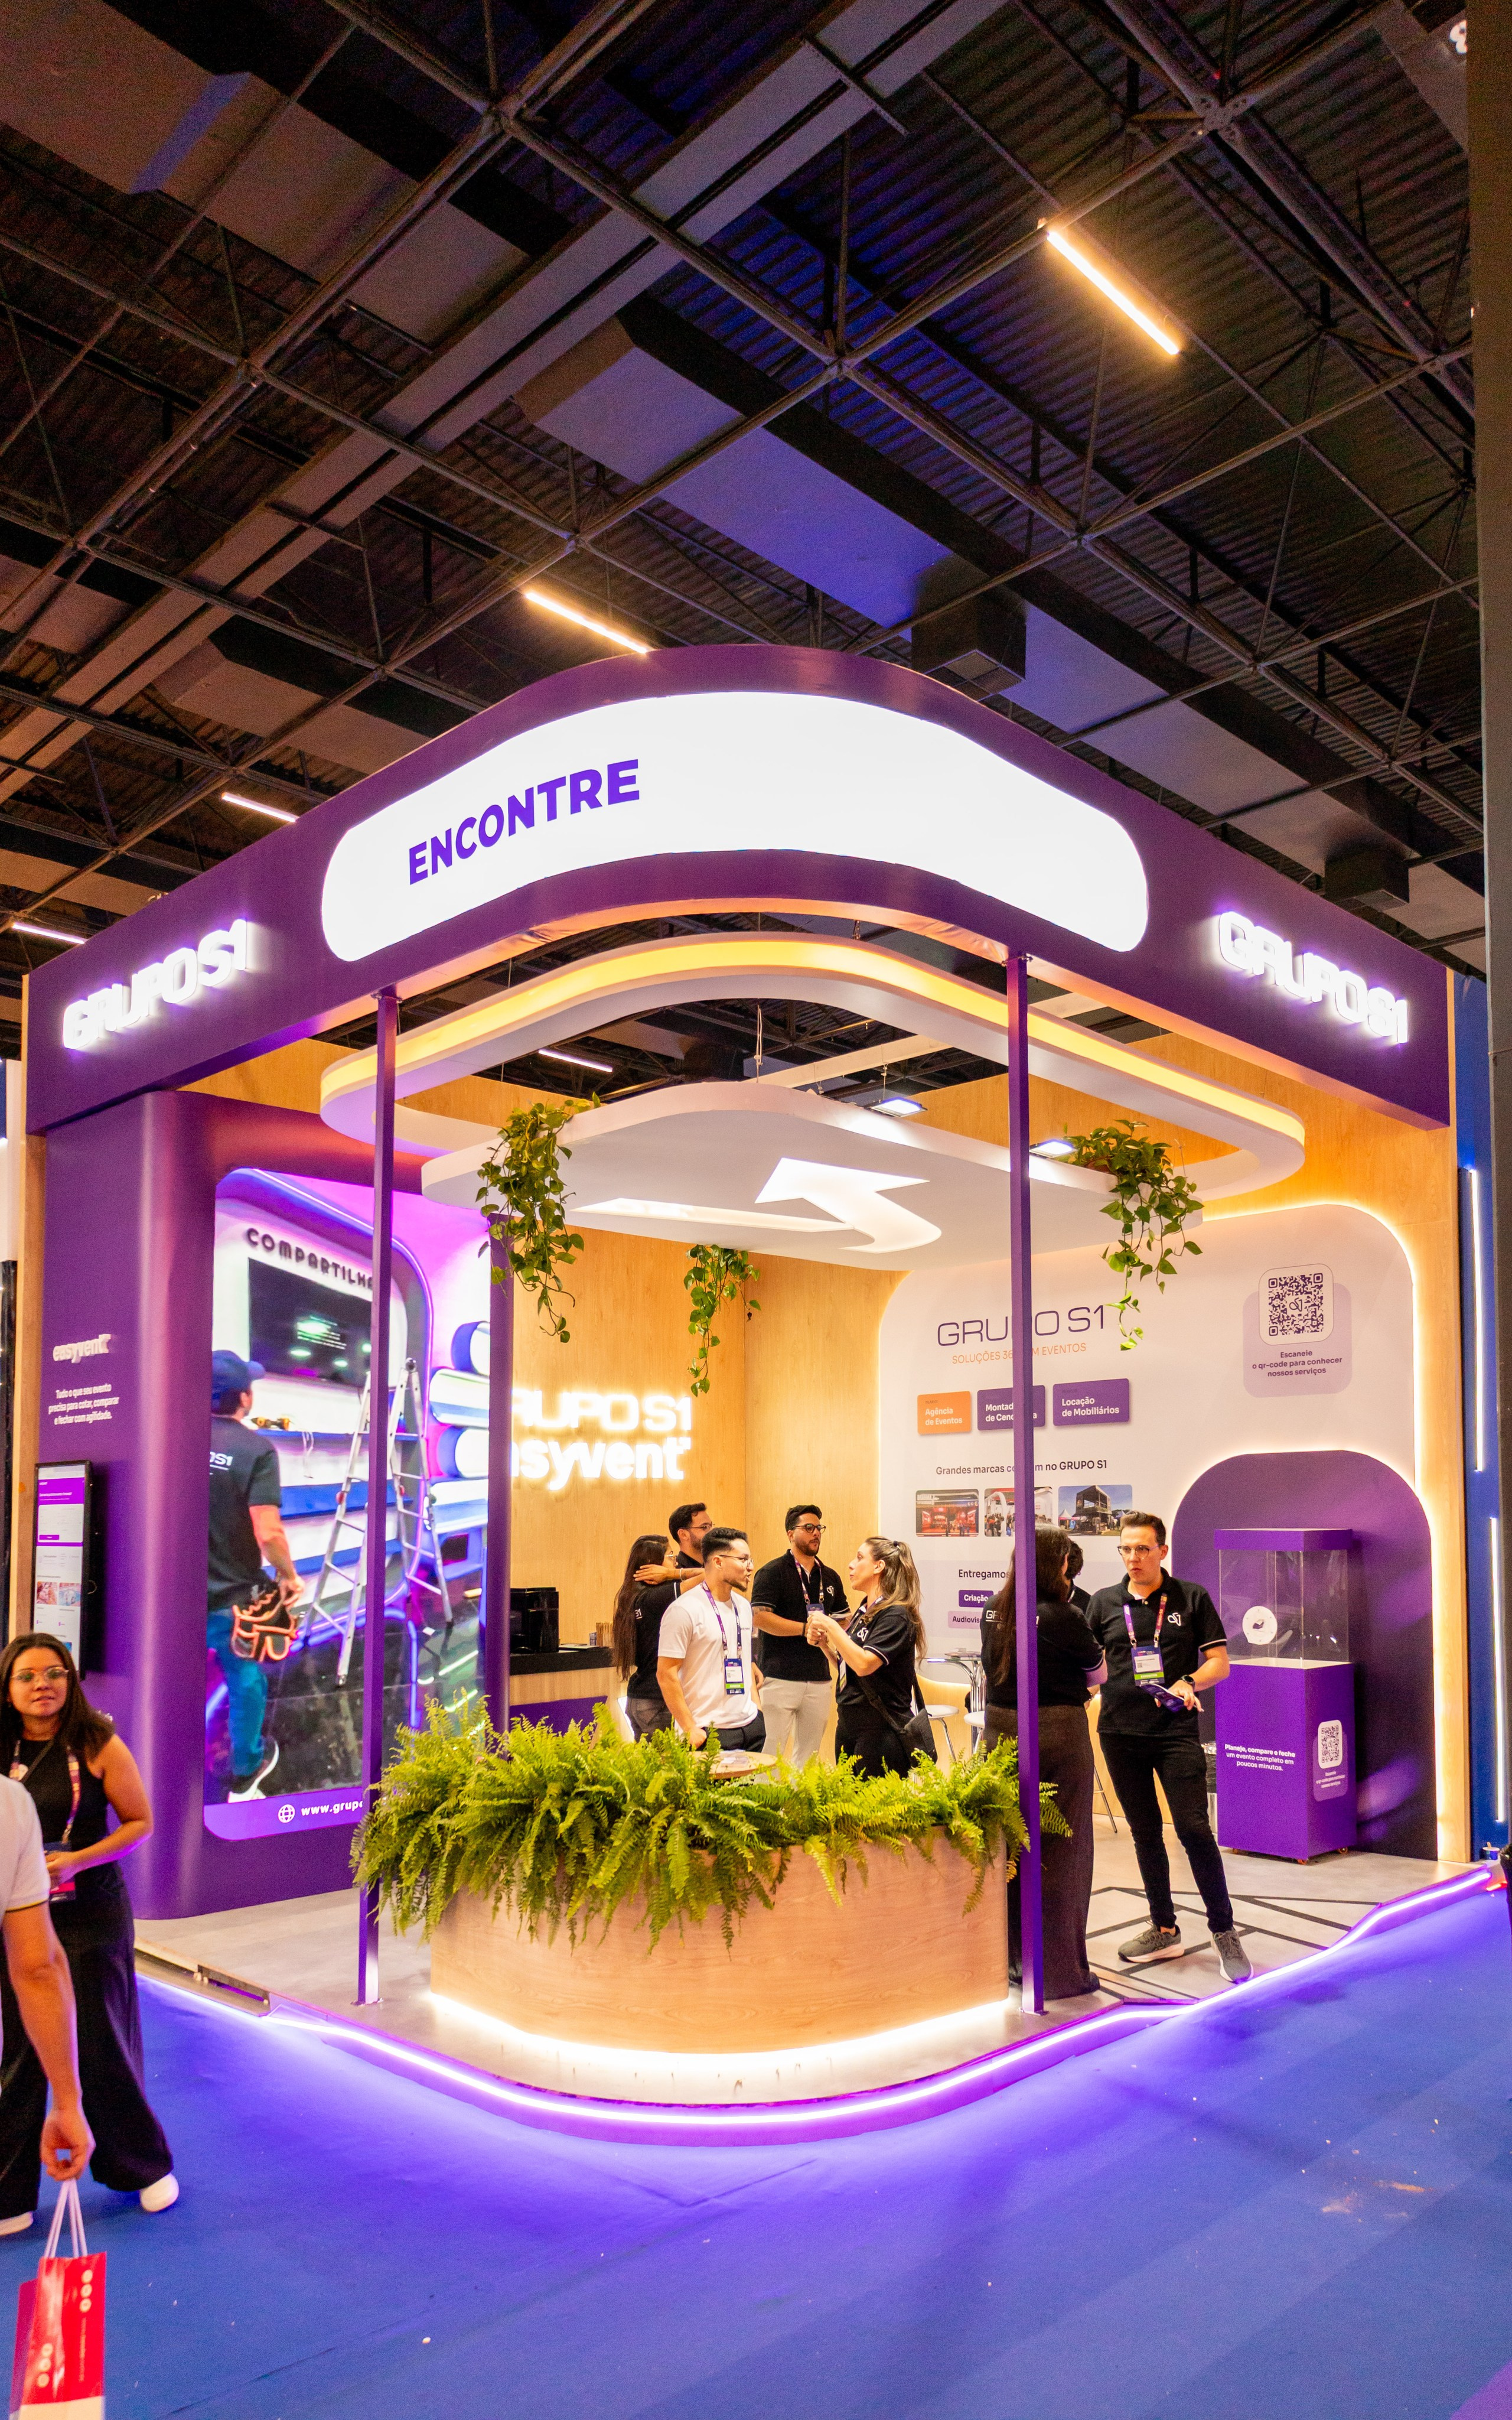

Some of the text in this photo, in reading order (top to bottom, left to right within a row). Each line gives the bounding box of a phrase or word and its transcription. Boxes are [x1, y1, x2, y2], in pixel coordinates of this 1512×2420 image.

[409, 759, 640, 885] ENCONTRE
[937, 1310, 1060, 1346] GRUO
[952, 1351, 1001, 1364] SOLUÇÕES
[1042, 1342, 1087, 1356] EVENTOS
[1280, 1350, 1312, 1358] Escaneie
[1259, 1361, 1288, 1370] qr-code
[1307, 1357, 1342, 1366] conhecer
[1295, 1367, 1327, 1376] serviços
[985, 1403, 1014, 1411] Montad
[1062, 1396, 1095, 1407] Locação
[925, 1407, 953, 1417] Agência
[1073, 1406, 1120, 1416] Mobiliários
[511, 1436, 685, 1491] syvent
[936, 1466, 972, 1475] Grandes
[973, 1465, 1005, 1474] marcas
[1059, 1461, 1095, 1470] GRUPO
[1097, 1460, 1107, 1469] S1
[964, 1594, 989, 1603] Criação
[301, 1801, 363, 1816] www.grup
